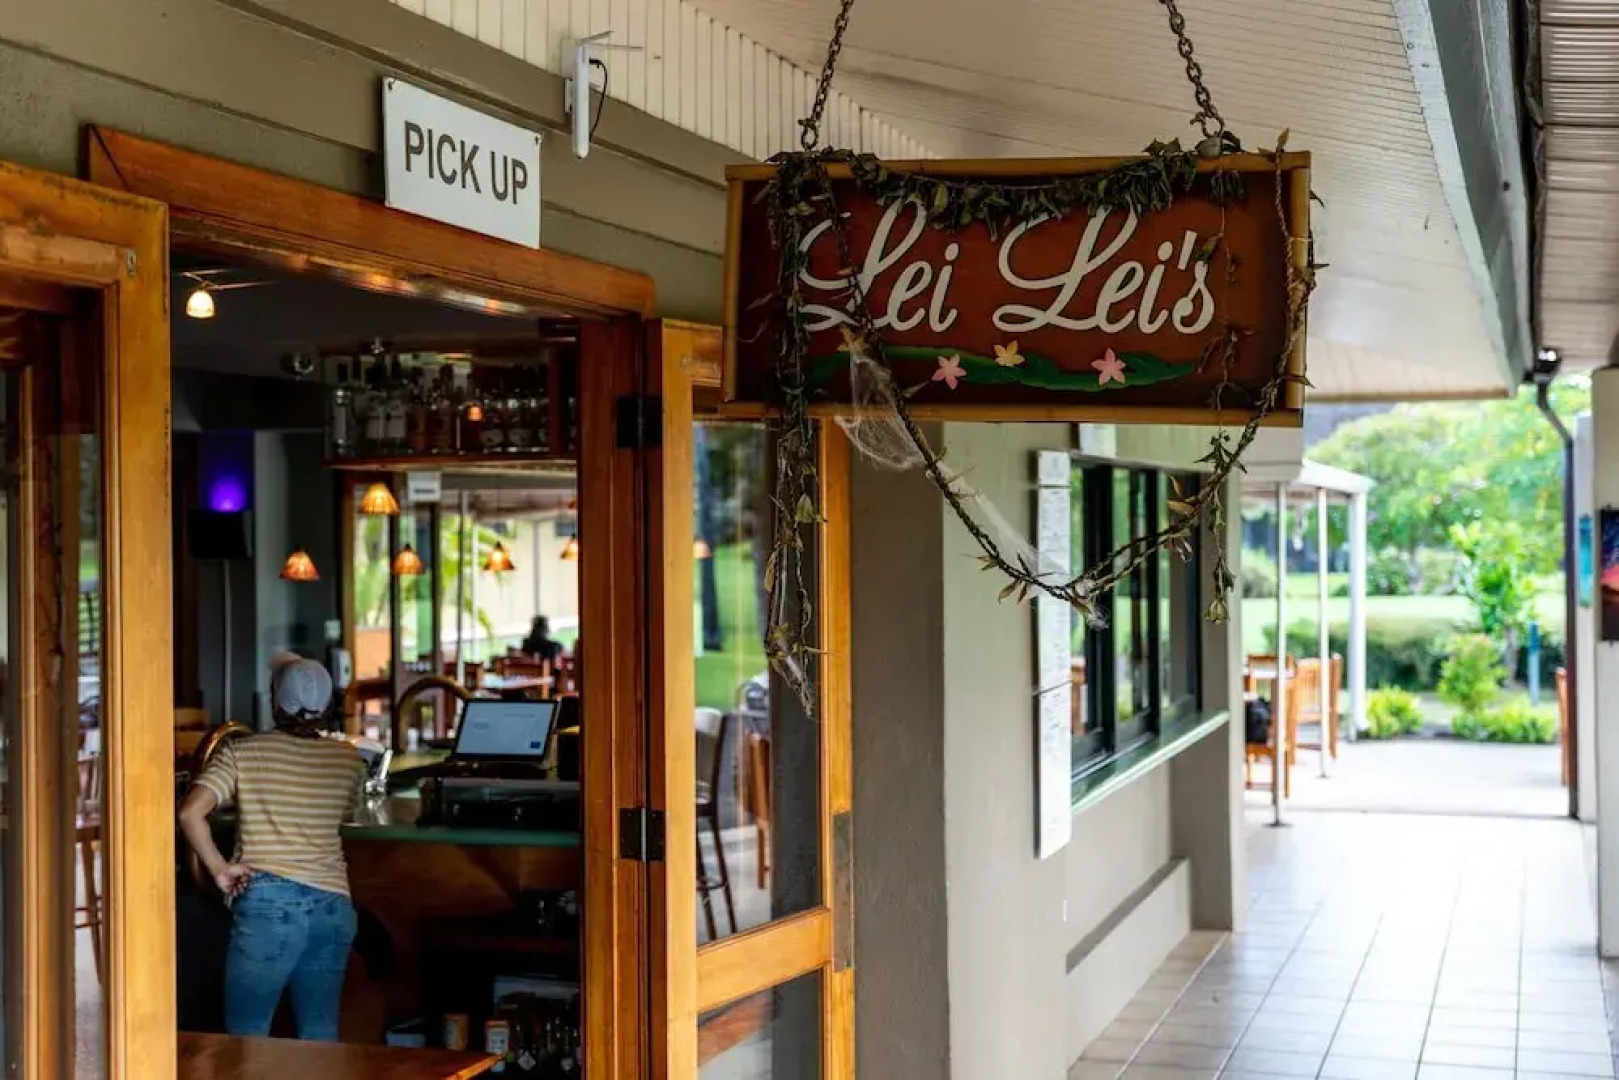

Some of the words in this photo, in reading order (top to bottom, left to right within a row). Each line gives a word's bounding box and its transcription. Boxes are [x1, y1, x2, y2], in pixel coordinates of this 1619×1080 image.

[404, 120, 481, 194] PICK
[490, 150, 528, 205] UP
[796, 197, 960, 333] Lei
[992, 198, 1215, 335] Lei's
